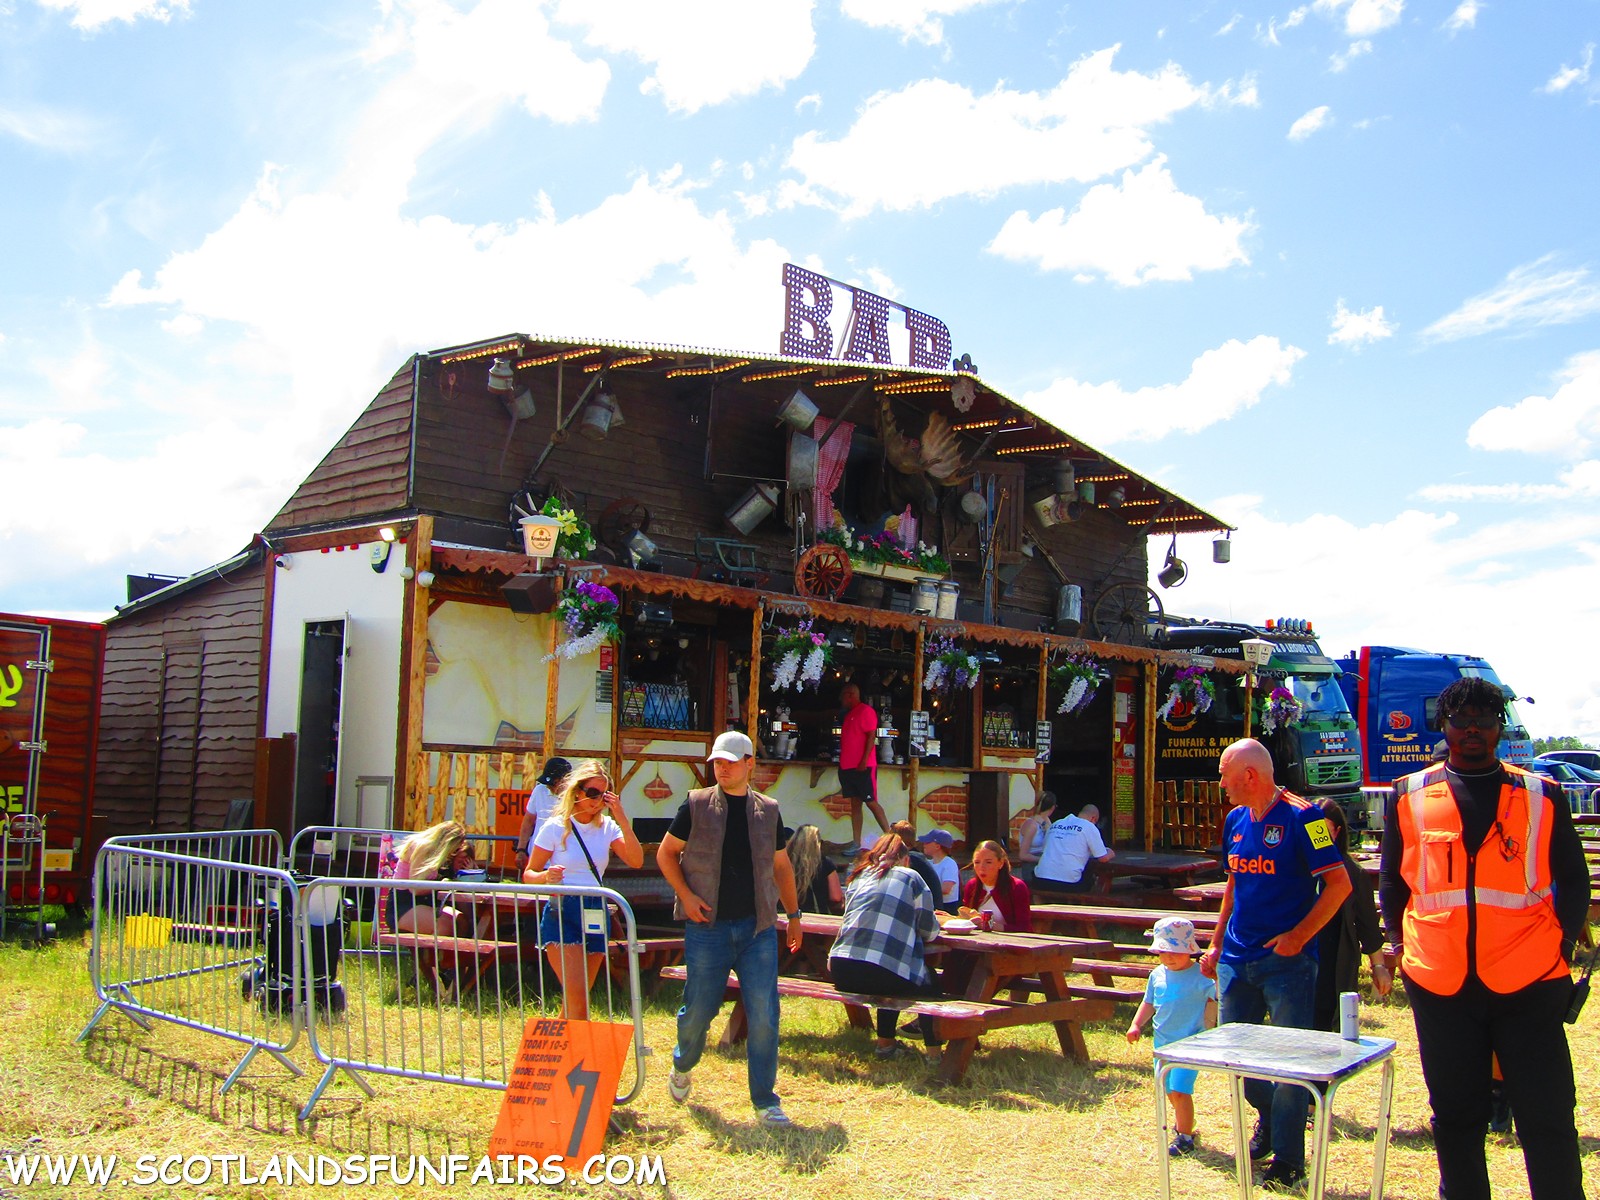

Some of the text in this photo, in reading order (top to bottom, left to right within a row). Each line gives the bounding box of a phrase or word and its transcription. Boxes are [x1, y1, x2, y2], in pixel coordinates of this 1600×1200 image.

[1168, 738, 1206, 747] FUNFAIR
[1209, 738, 1216, 747] &
[1161, 748, 1220, 758] ATTRACTIONS
[1387, 744, 1431, 753] FUNFAIR &
[1239, 855, 1276, 875] sela
[532, 1020, 567, 1036] FREE
[523, 1039, 569, 1050] TODAY 10-5
[520, 1053, 562, 1063] FAIRGROUND
[514, 1067, 558, 1077] MODEL SHOW
[510, 1080, 552, 1092] SCALE RIDES
[507, 1095, 547, 1106] FAMILY FUN
[515, 1139, 545, 1149] COFFEE
